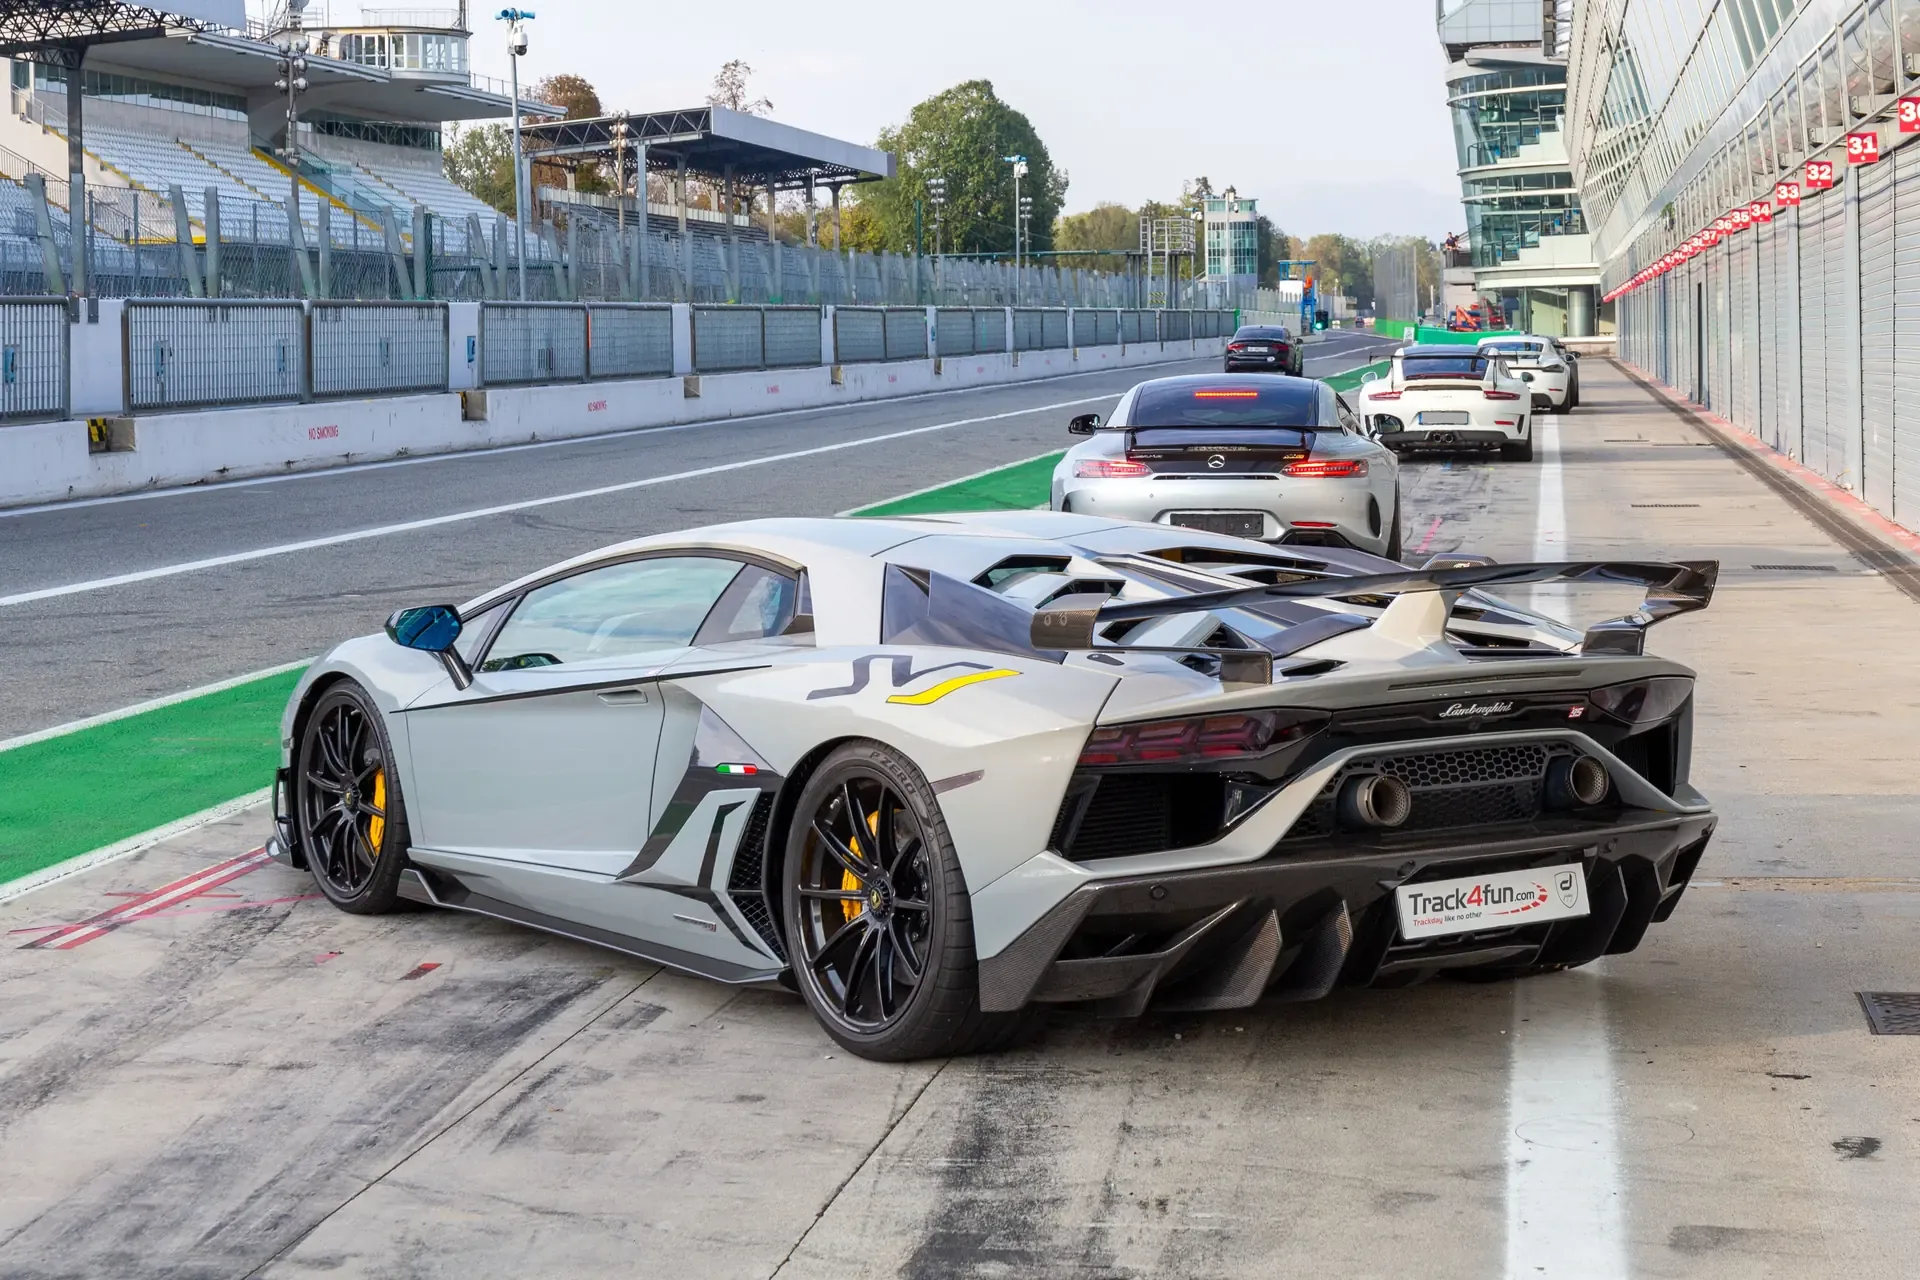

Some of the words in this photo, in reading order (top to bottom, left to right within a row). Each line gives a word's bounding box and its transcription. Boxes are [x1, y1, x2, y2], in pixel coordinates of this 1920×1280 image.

[1900, 101, 1920, 123] 3
[1848, 136, 1877, 155] 31
[1807, 164, 1832, 181] 32
[1777, 185, 1799, 199] 33
[1731, 210, 1750, 223] 35
[1751, 203, 1770, 216] 34
[1716, 219, 1732, 230] 36
[1702, 230, 1717, 241] 37
[308, 428, 316, 440] NO
[317, 425, 339, 440] SMOKING
[1439, 701, 1514, 718] Lamborghini
[881, 757, 917, 796] ZERO
[1408, 883, 1535, 916] Track4fun.com
[1413, 916, 1443, 927] Trackday
[1444, 914, 1455, 922] like
[1465, 911, 1482, 920] other
